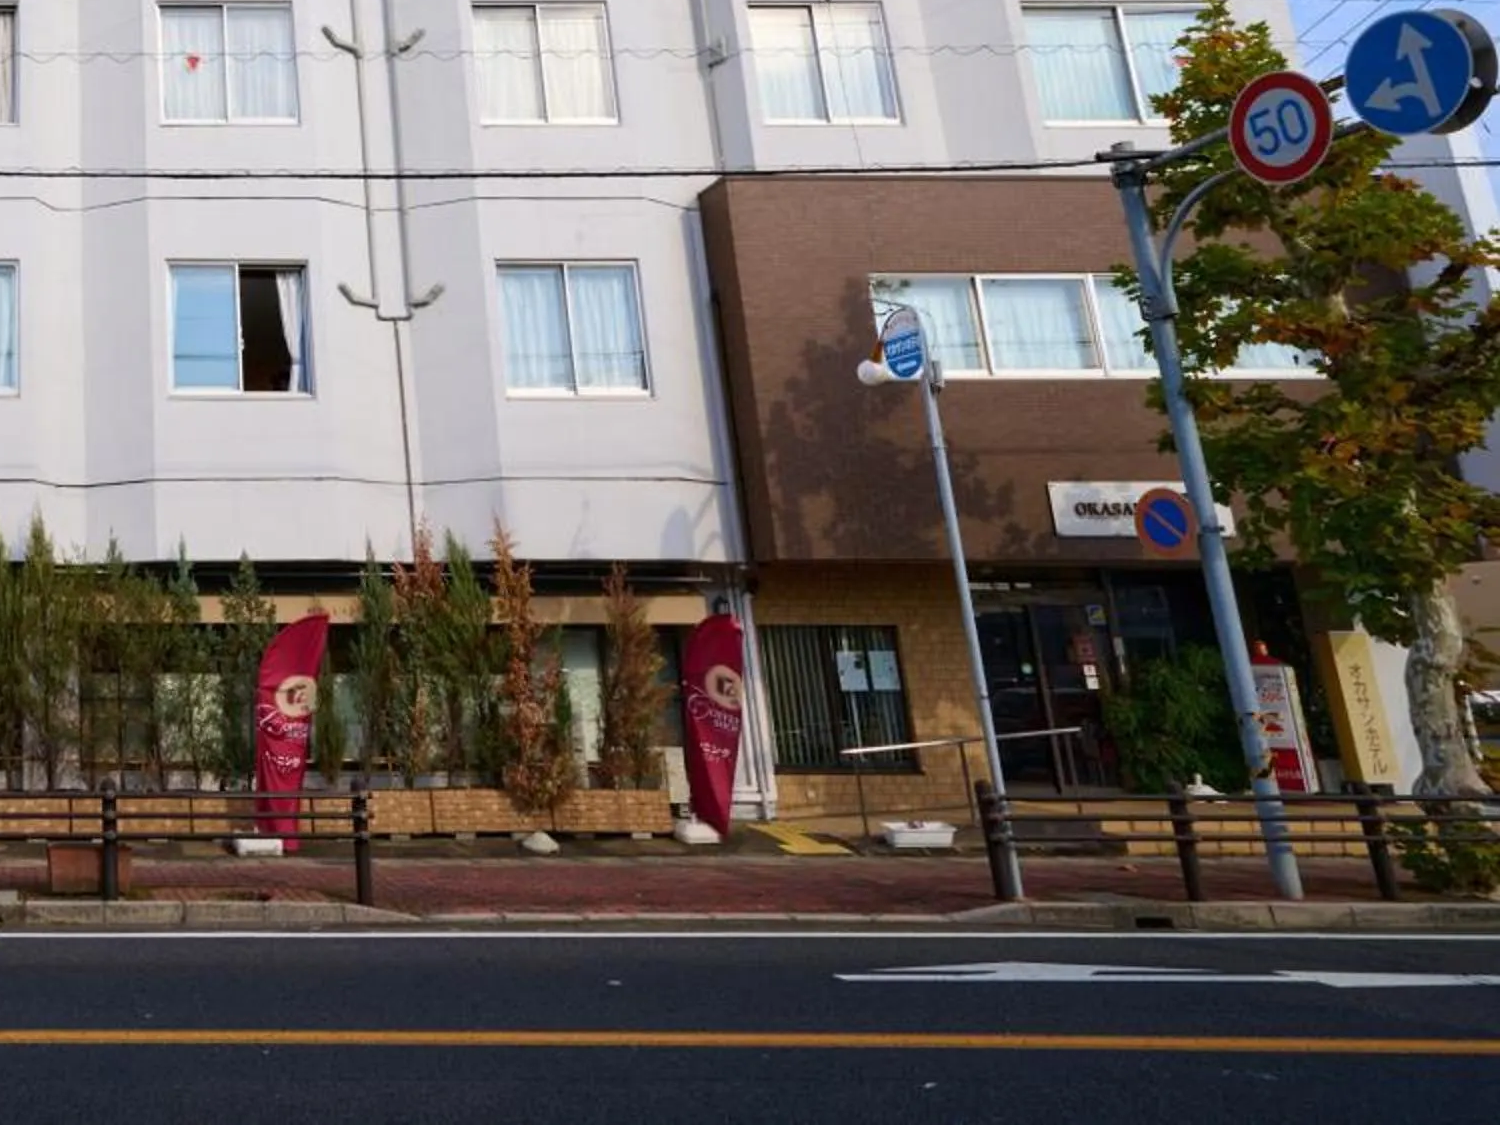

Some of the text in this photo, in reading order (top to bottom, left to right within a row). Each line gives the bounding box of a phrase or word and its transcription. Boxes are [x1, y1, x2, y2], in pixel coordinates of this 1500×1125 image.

[1248, 98, 1309, 156] 50
[1074, 501, 1137, 517] OKASA
[1349, 663, 1389, 776] オカサンホテル
